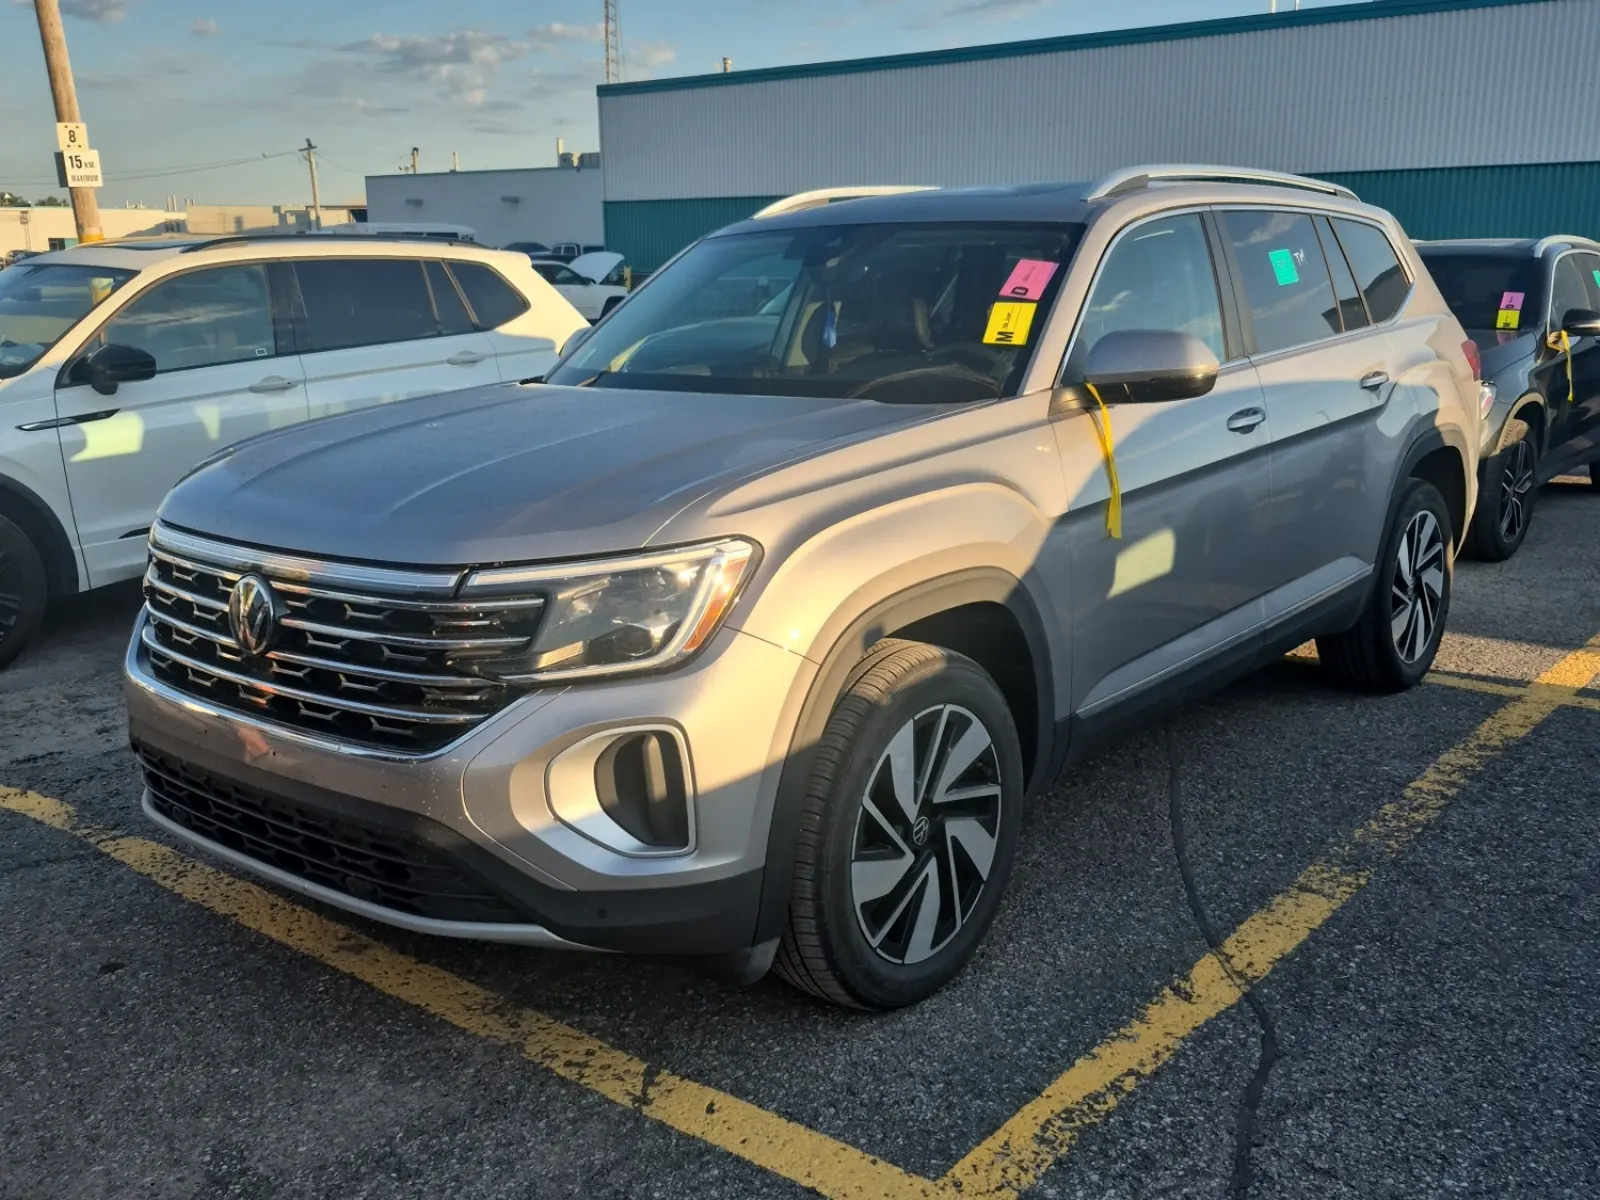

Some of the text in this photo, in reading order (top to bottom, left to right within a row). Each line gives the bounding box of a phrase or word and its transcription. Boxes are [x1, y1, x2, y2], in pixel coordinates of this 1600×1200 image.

[68, 130, 76, 143] 8
[68, 155, 83, 169] 15
[71, 174, 99, 182] MAXIMUM
[995, 331, 1014, 342] M
